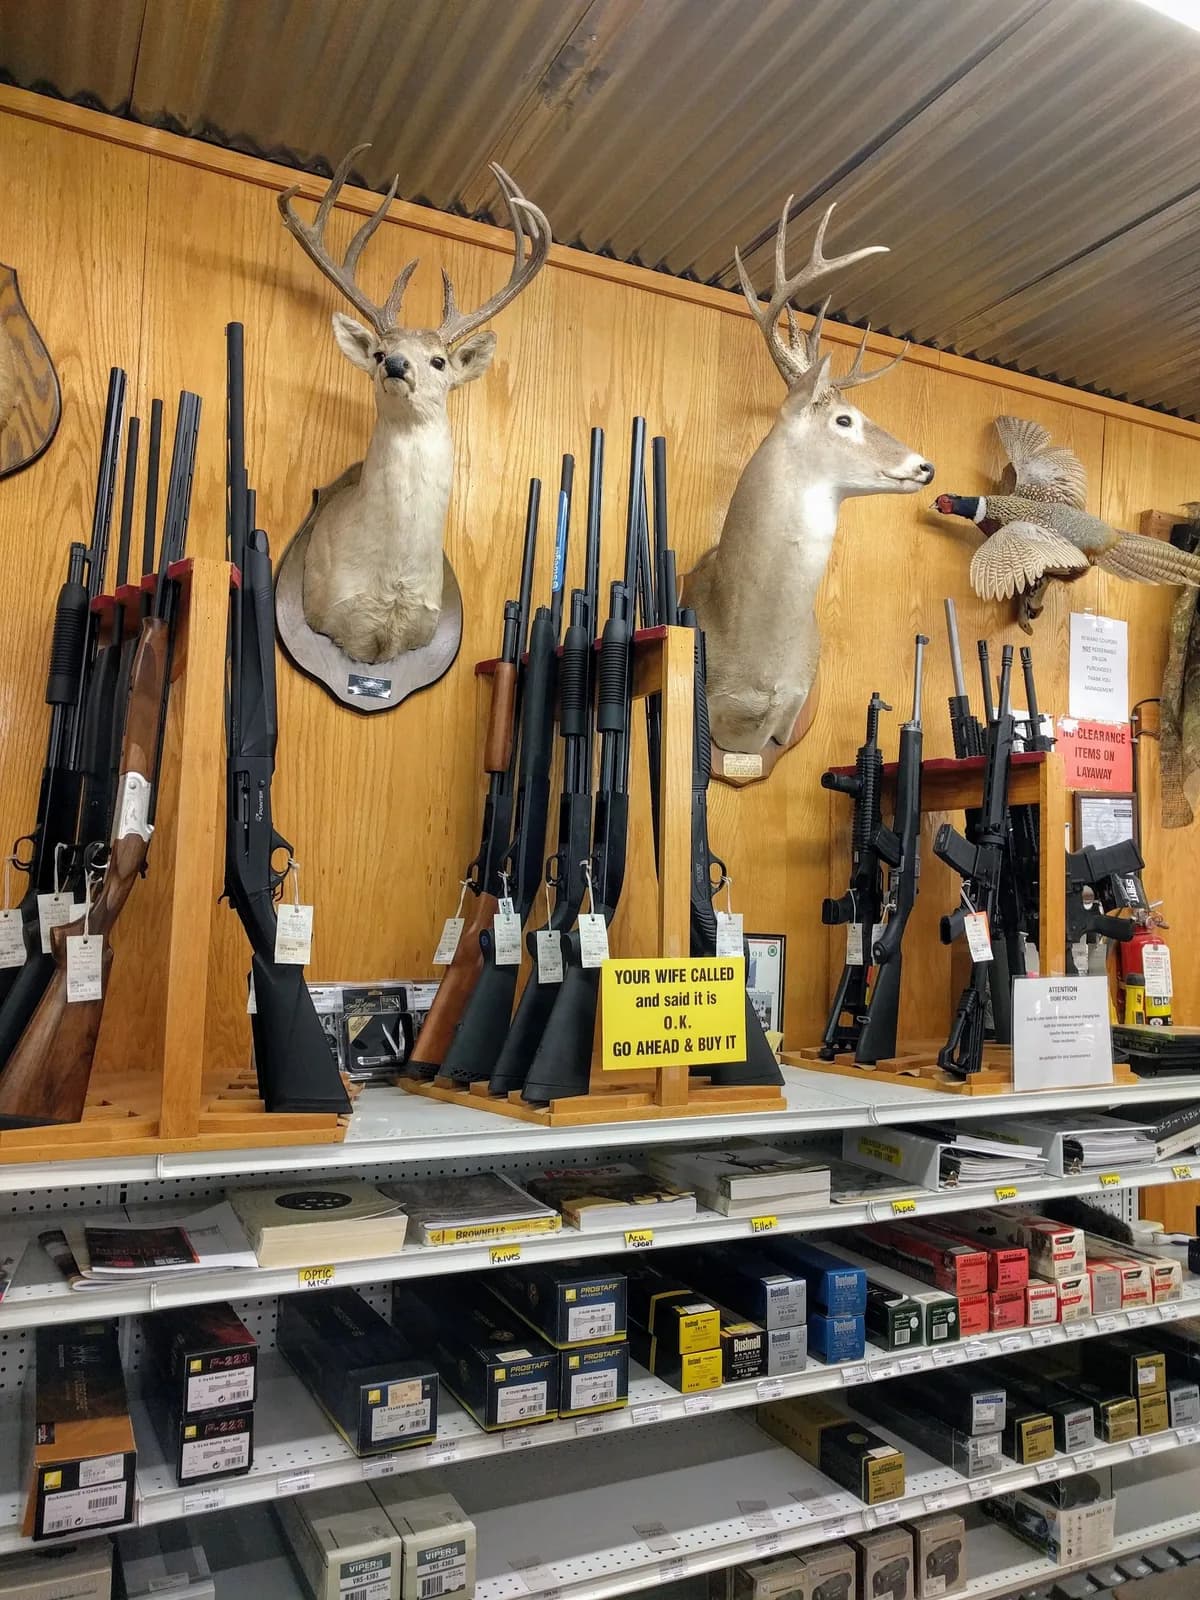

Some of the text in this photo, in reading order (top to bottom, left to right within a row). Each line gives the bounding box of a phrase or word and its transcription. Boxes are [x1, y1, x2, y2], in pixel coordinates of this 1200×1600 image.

[1077, 728, 1126, 744] CLEARANCE
[1075, 747, 1115, 761] ITEMS ON
[1076, 765, 1112, 780] LAYAWAY
[615, 967, 734, 985] YOUR WIFE CALLED
[636, 991, 717, 1008] and said it is
[664, 1015, 692, 1030] O.K.
[613, 1035, 737, 1057] GO AHEAD & BUY IT
[455, 1226, 506, 1240] BROWNELLS
[304, 1269, 332, 1281] OPTIC
[580, 1283, 619, 1295] PROSTAFF
[734, 1335, 761, 1353] Bushnell
[584, 1349, 622, 1361] PROSTAFF
[511, 1360, 550, 1373] PROSTAFF
[425, 1547, 452, 1560] VIPER
[348, 1561, 377, 1573] VIPER
